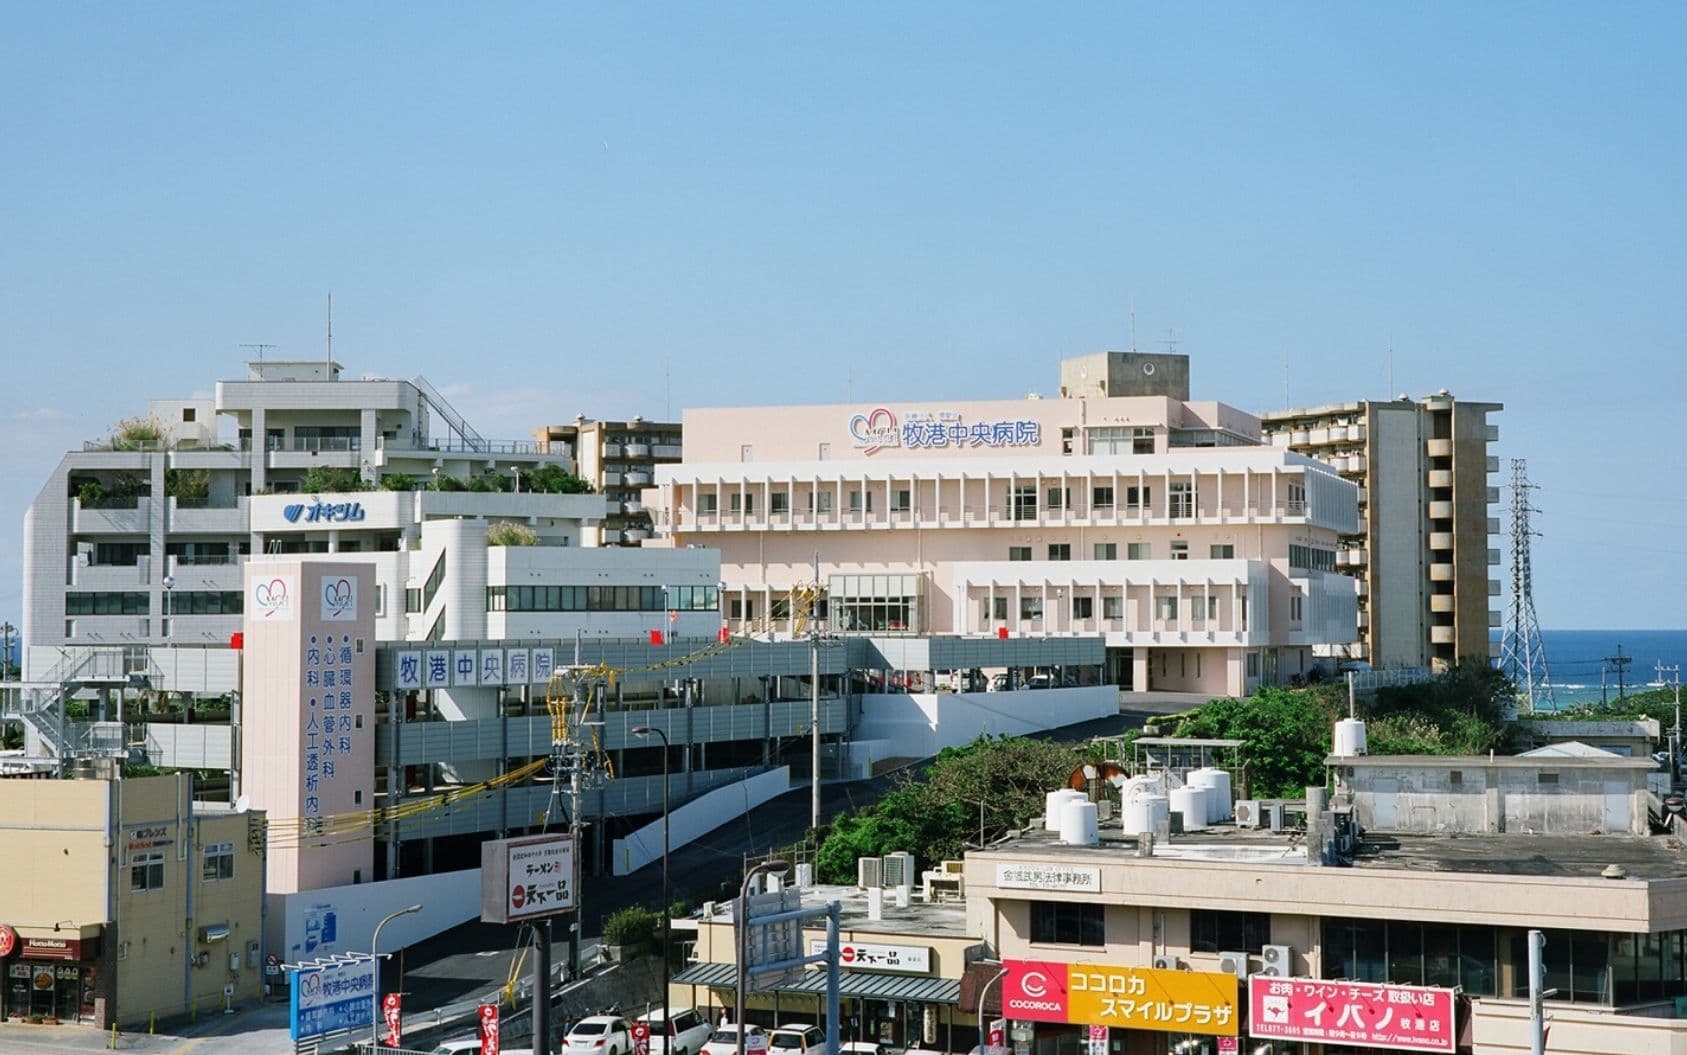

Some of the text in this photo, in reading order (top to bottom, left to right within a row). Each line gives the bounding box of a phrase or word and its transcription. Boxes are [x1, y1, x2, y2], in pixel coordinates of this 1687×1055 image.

[902, 420, 1039, 446] 牧港中央病院
[401, 654, 551, 684] 牧港中央病院
[339, 646, 352, 753] 循環器内科
[526, 862, 555, 877] ラーメン
[526, 880, 569, 905] 天下一品
[856, 949, 900, 965] 天下一品
[1071, 972, 1146, 995] ココロカ
[1009, 1000, 1062, 1011] COCOROCA
[1100, 998, 1233, 1025] スマイルプラザ
[1304, 1001, 1394, 1031] イバノ
